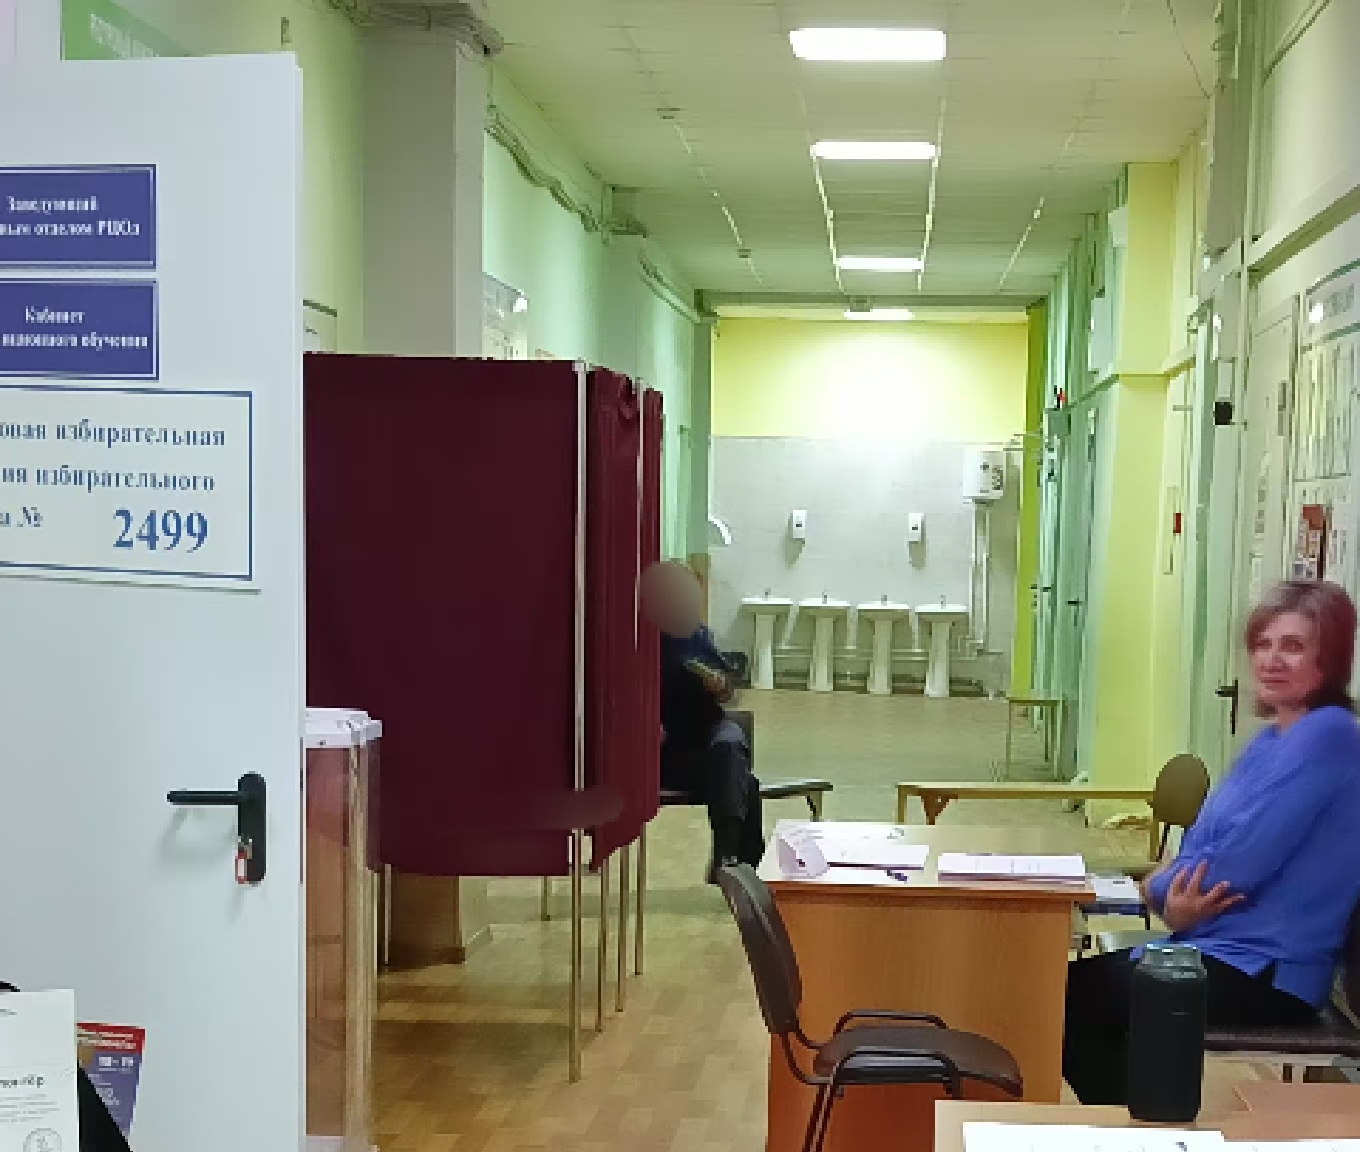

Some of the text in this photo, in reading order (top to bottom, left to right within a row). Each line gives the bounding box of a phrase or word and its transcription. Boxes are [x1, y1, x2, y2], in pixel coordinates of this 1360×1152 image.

[56, 419, 226, 448] избирательная
[36, 464, 215, 492] избирательного
[112, 507, 209, 554] 2499
